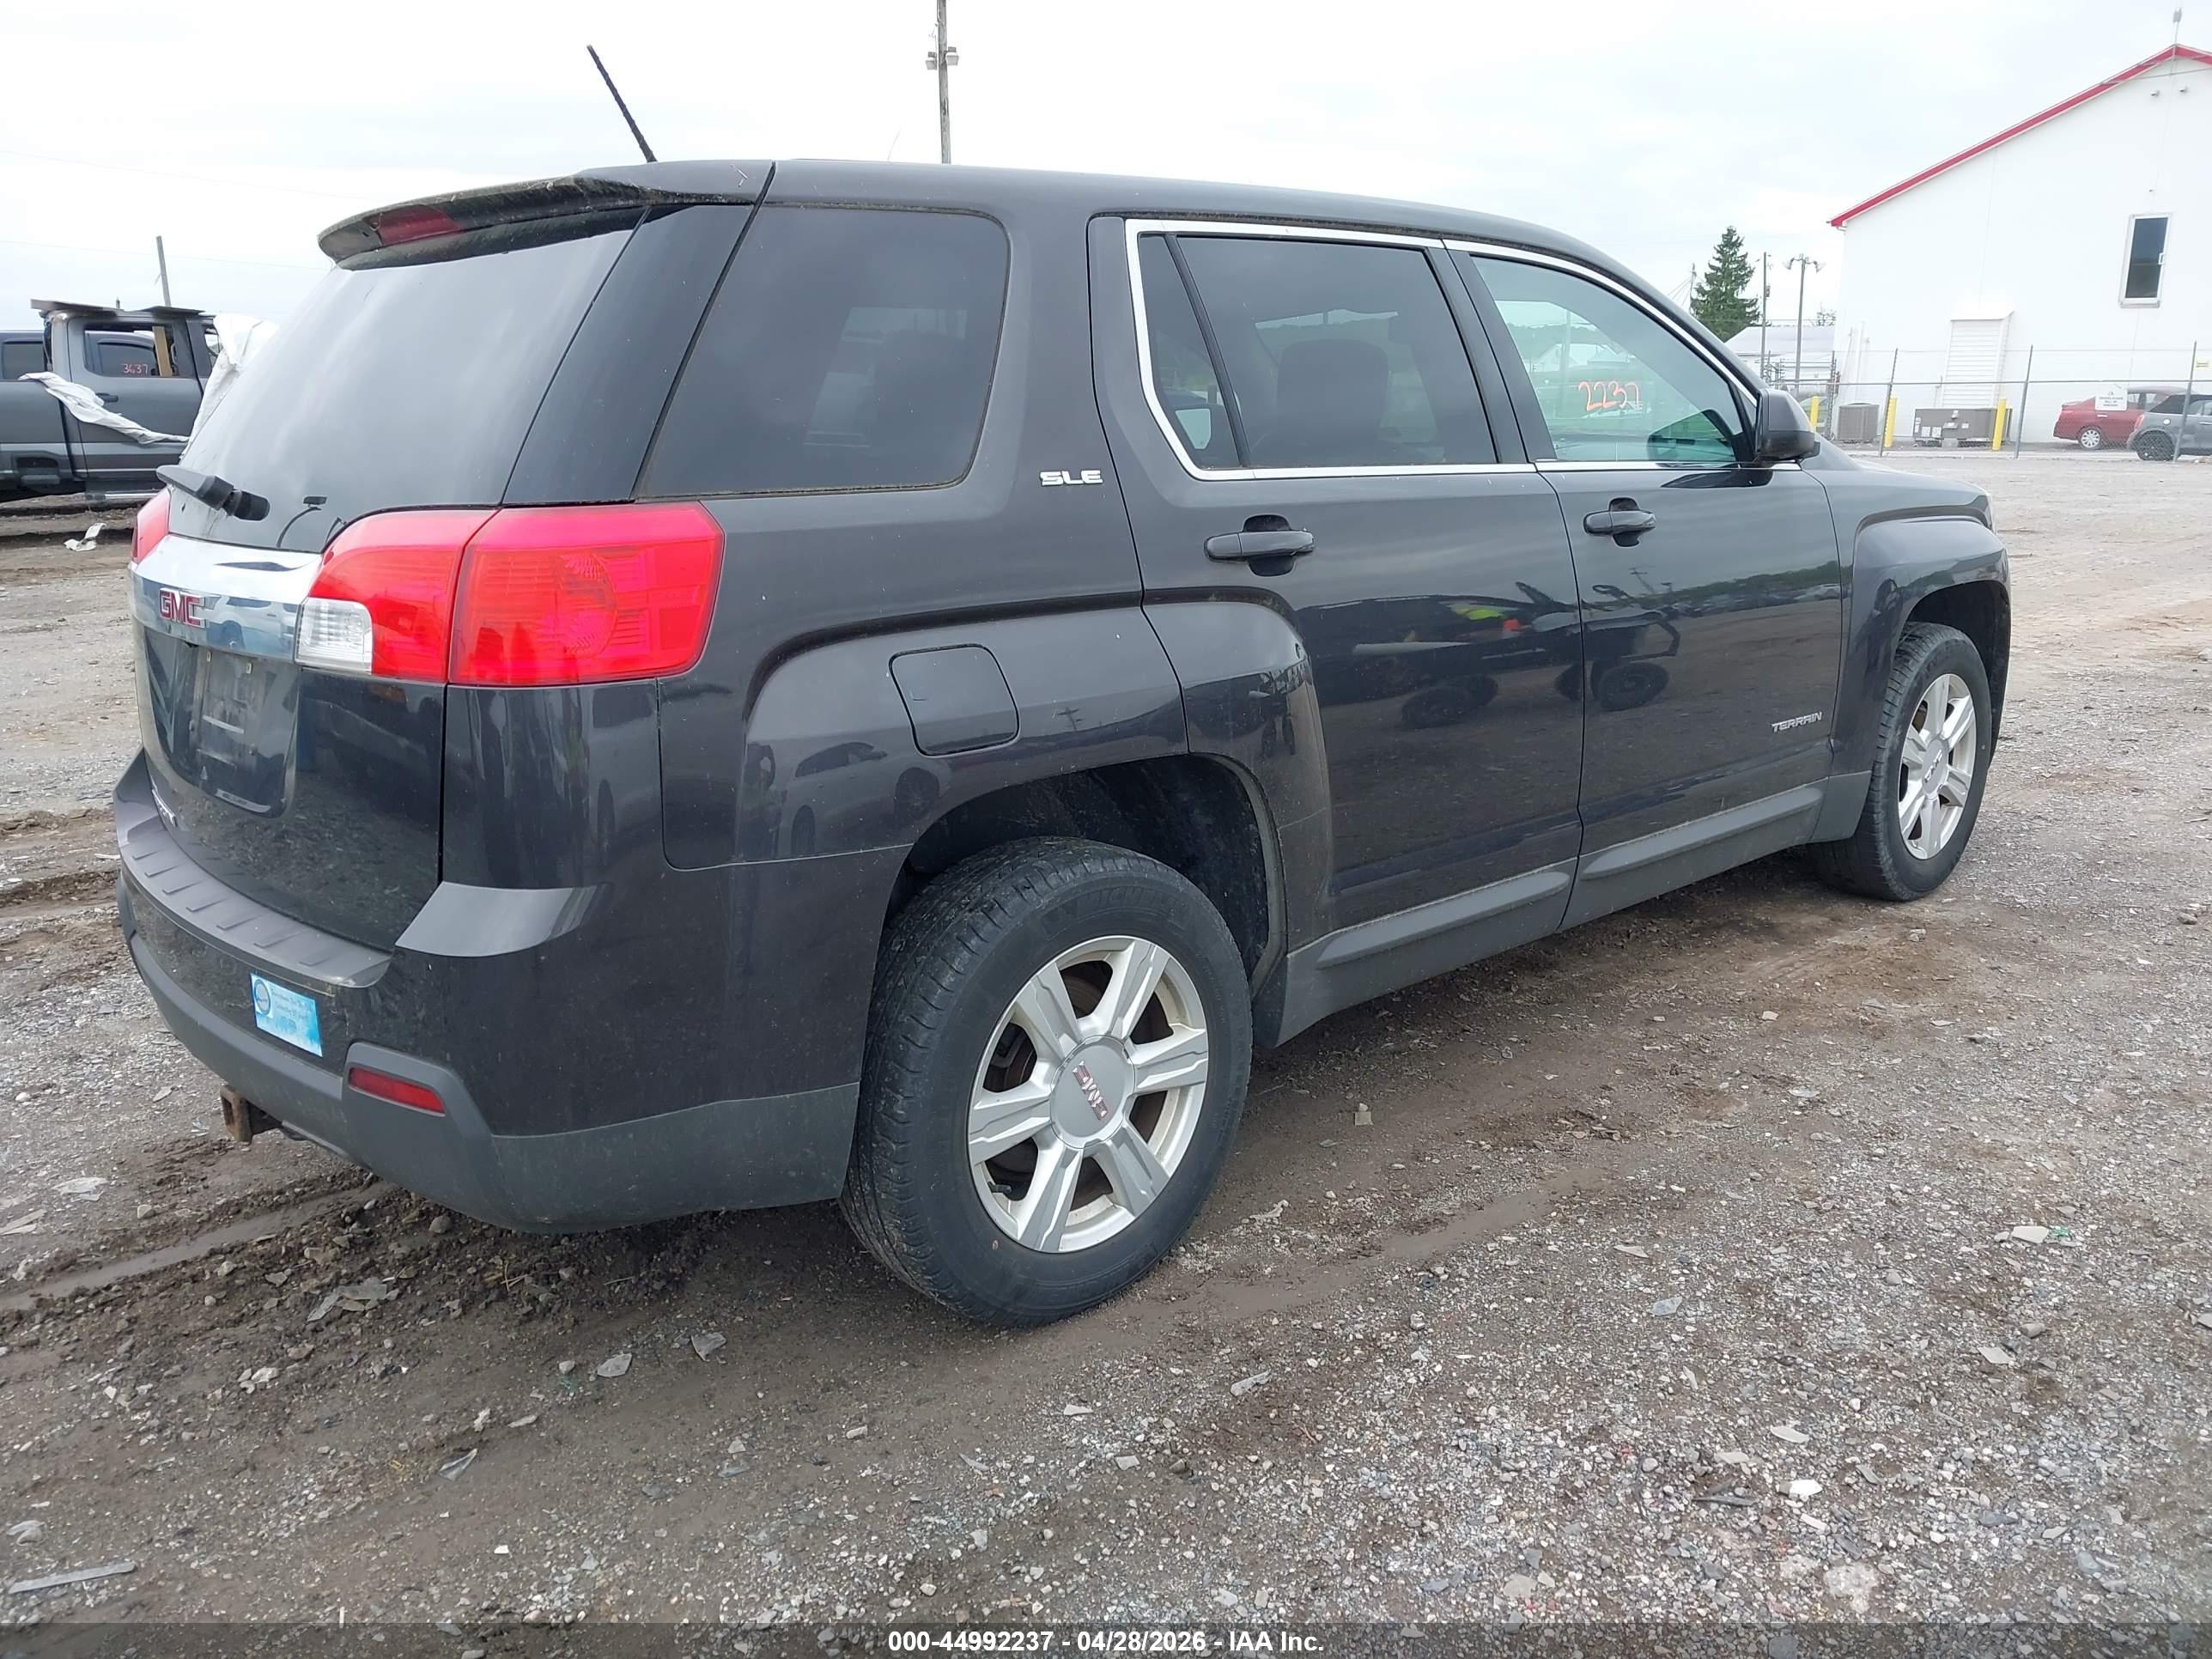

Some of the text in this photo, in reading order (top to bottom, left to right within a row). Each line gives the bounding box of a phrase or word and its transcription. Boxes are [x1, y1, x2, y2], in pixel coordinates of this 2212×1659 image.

[1578, 380, 1639, 412] 2237
[1040, 470, 1103, 486] SLE
[159, 587, 206, 629] GMC
[1771, 711, 1822, 732] TERRAIN
[1073, 1060, 1109, 1120] GMC
